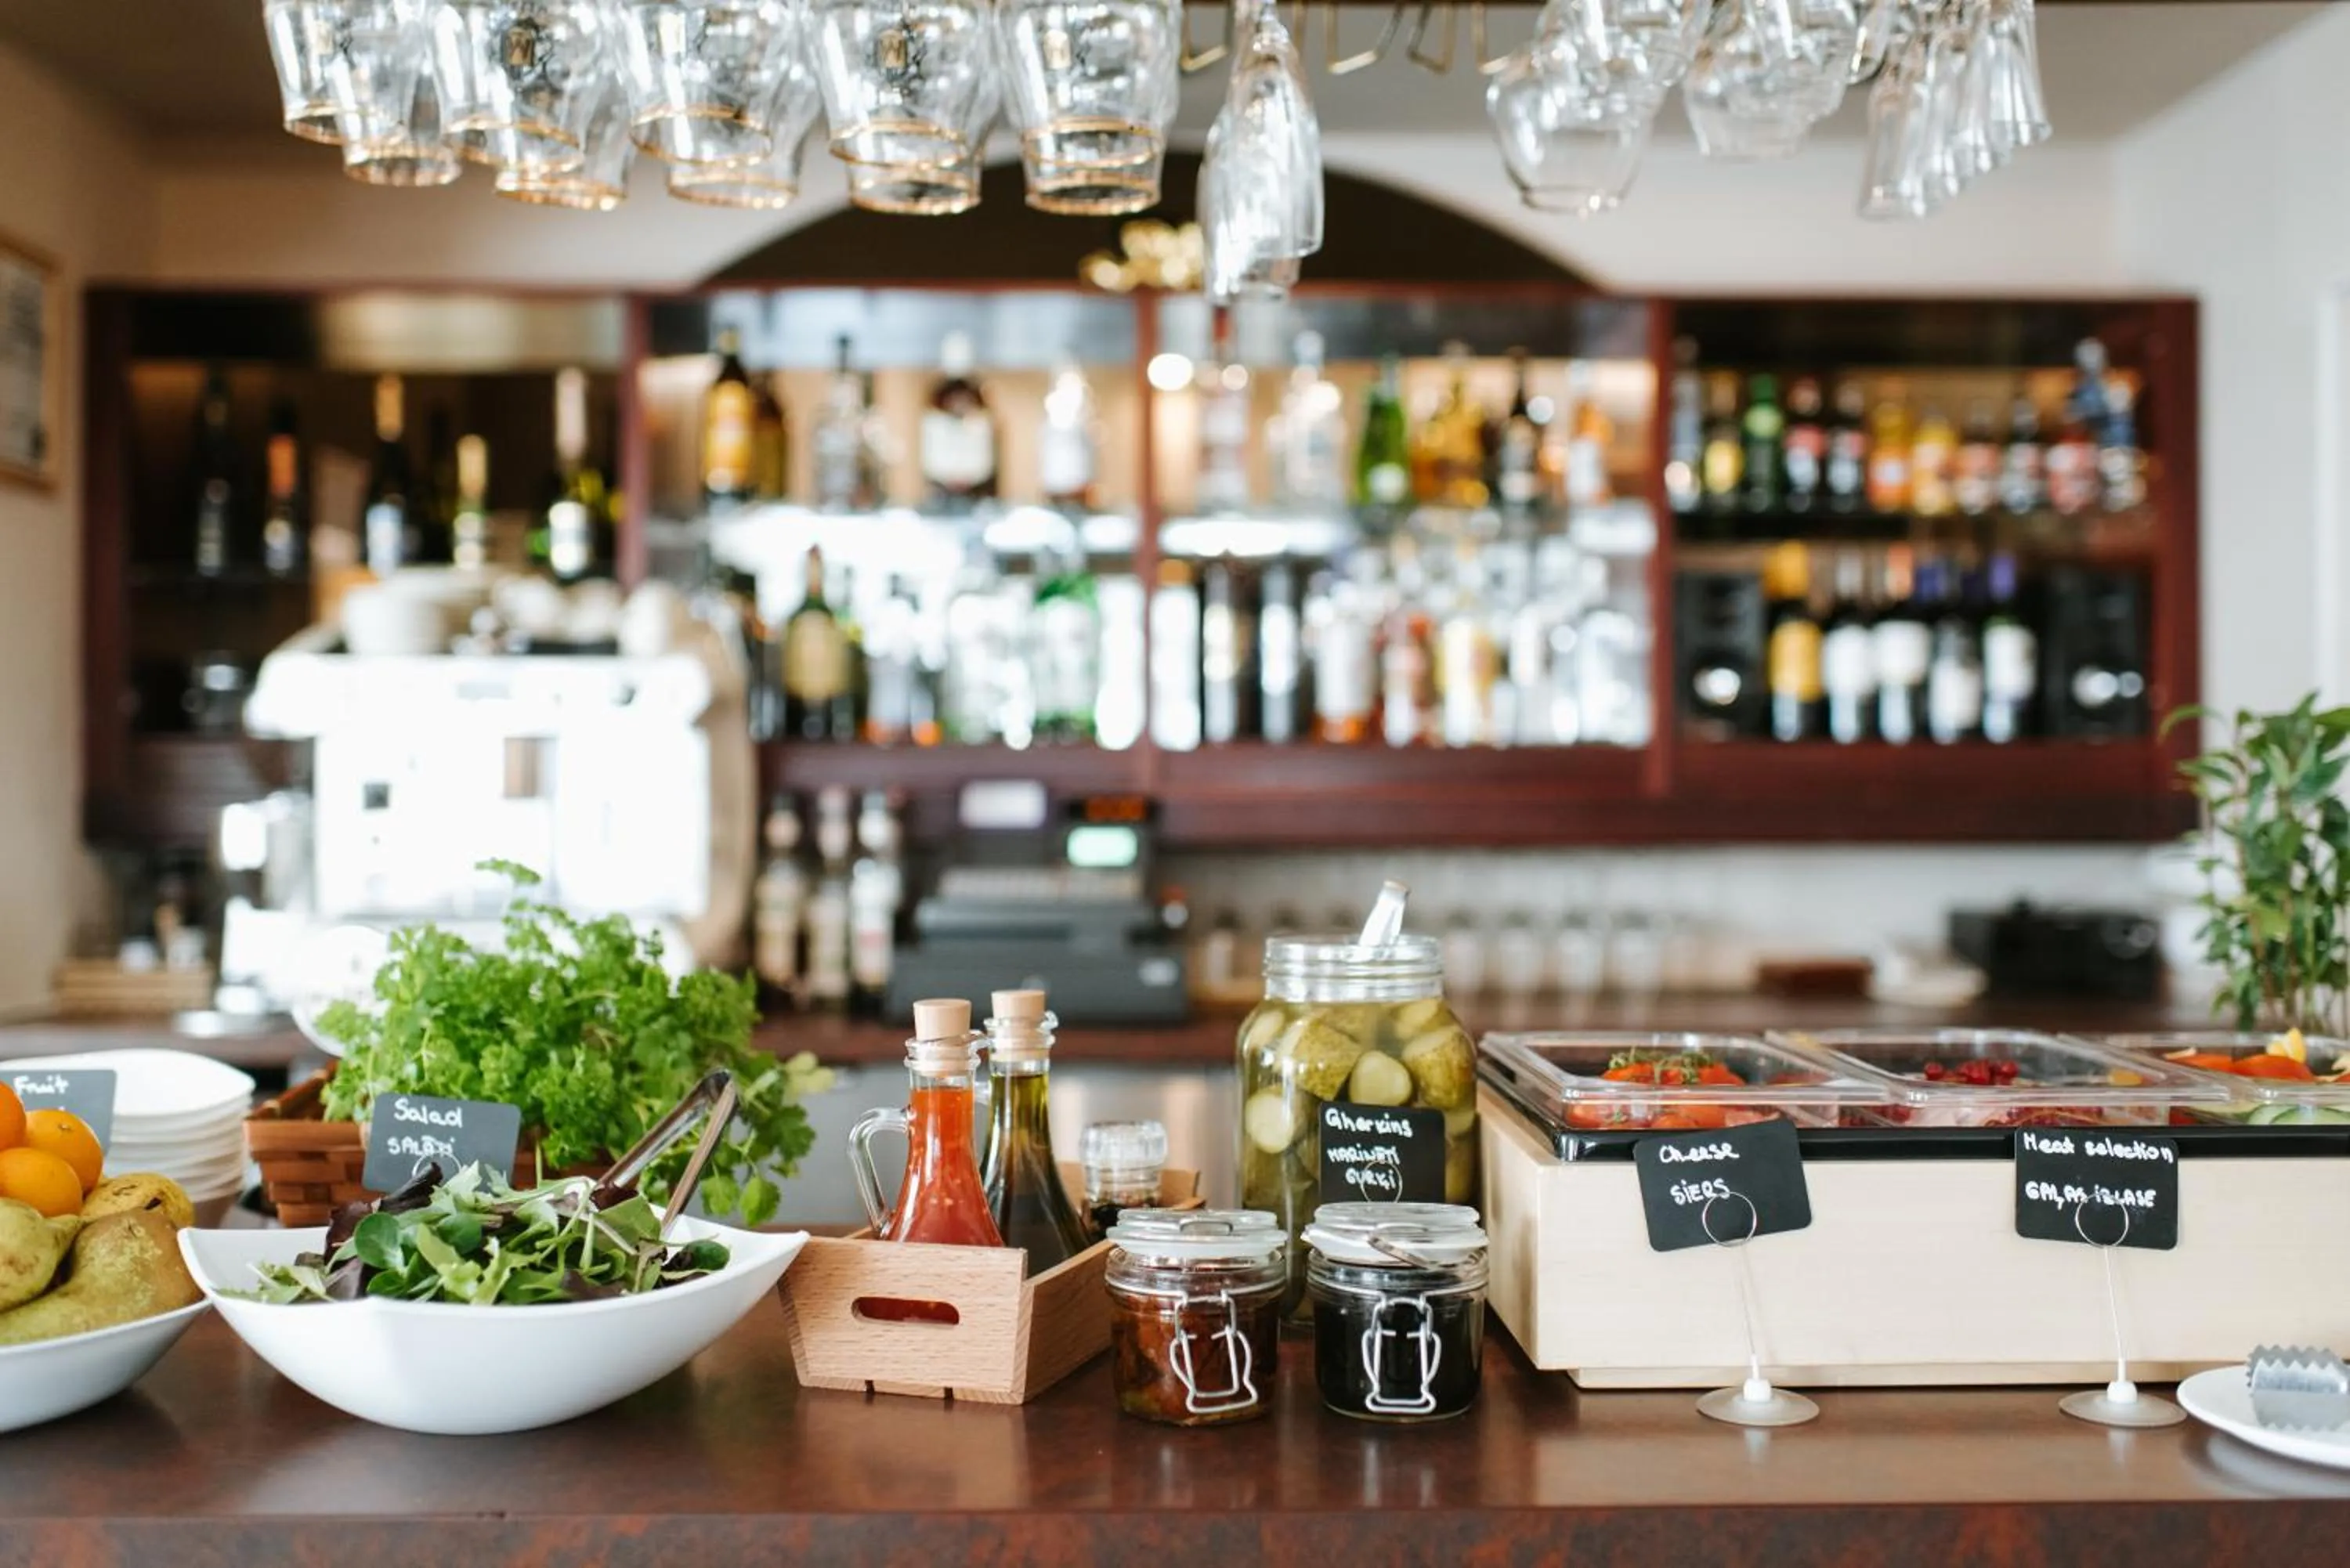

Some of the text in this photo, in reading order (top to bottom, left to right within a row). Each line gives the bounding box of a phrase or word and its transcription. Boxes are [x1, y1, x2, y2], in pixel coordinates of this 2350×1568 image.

[13, 1075, 69, 1097] Fruit
[393, 1097, 463, 1128] Salad
[1659, 1142, 1740, 1163] Cheese
[2023, 1132, 2174, 1164] Meat selection
